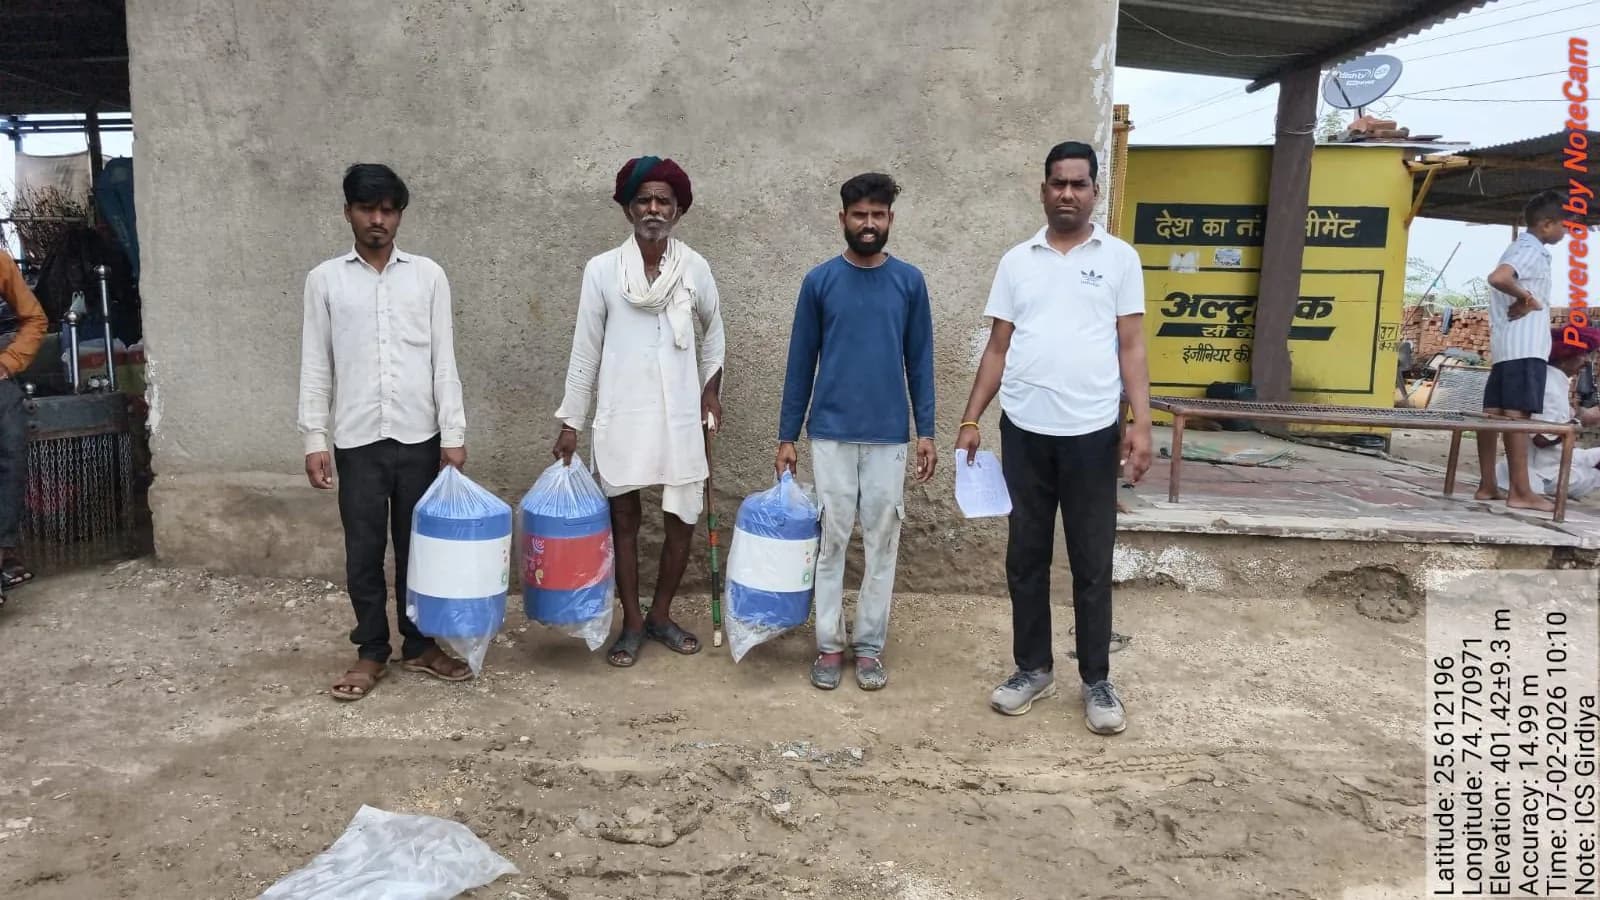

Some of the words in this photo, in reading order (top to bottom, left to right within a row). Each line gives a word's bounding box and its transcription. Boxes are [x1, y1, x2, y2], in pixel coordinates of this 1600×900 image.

[1155, 209, 1194, 239] देश
[1202, 218, 1230, 237] का
[1182, 343, 1232, 363] इंजीनियर
